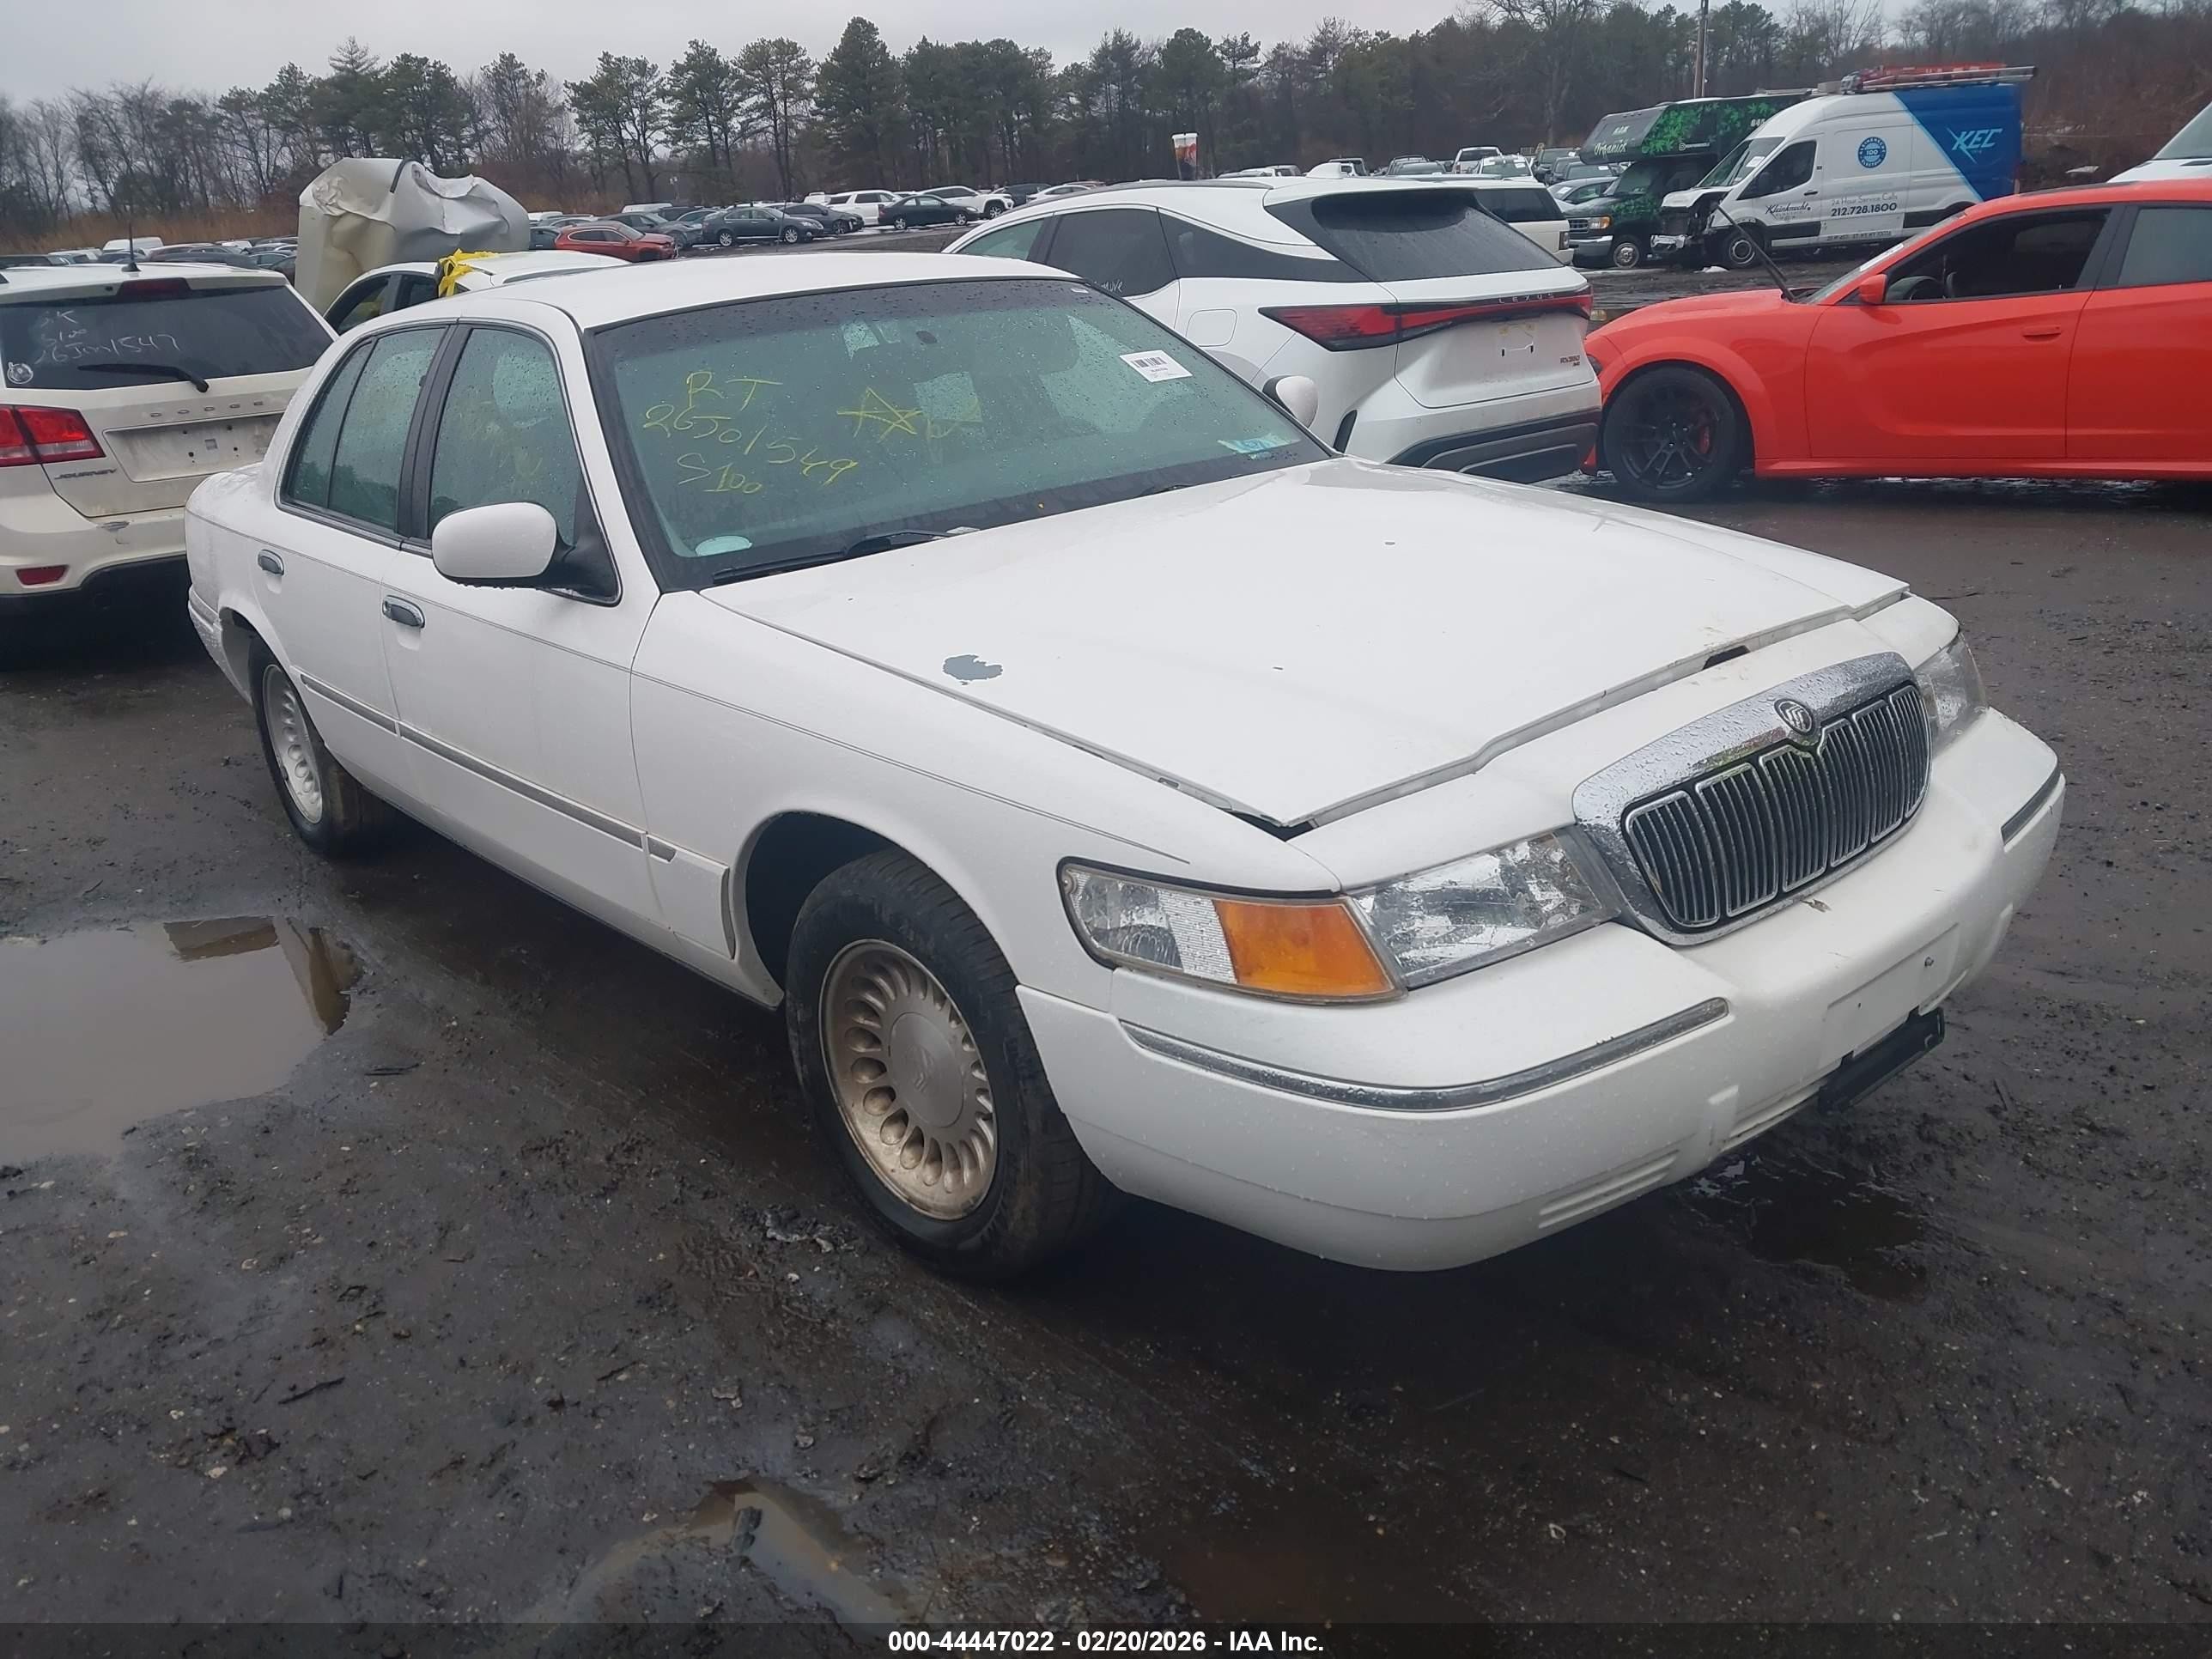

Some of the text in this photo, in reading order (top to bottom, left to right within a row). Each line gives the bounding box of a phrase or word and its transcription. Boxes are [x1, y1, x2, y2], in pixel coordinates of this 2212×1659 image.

[1594, 143, 1627, 158] Organics
[1948, 128, 2002, 160] KEC
[1841, 193, 1856, 204] Hour
[1858, 194, 1881, 204] Service
[1882, 192, 1898, 201] Calls
[1831, 203, 1897, 216] 212.728.1800
[1499, 293, 1555, 304] LEXUS
